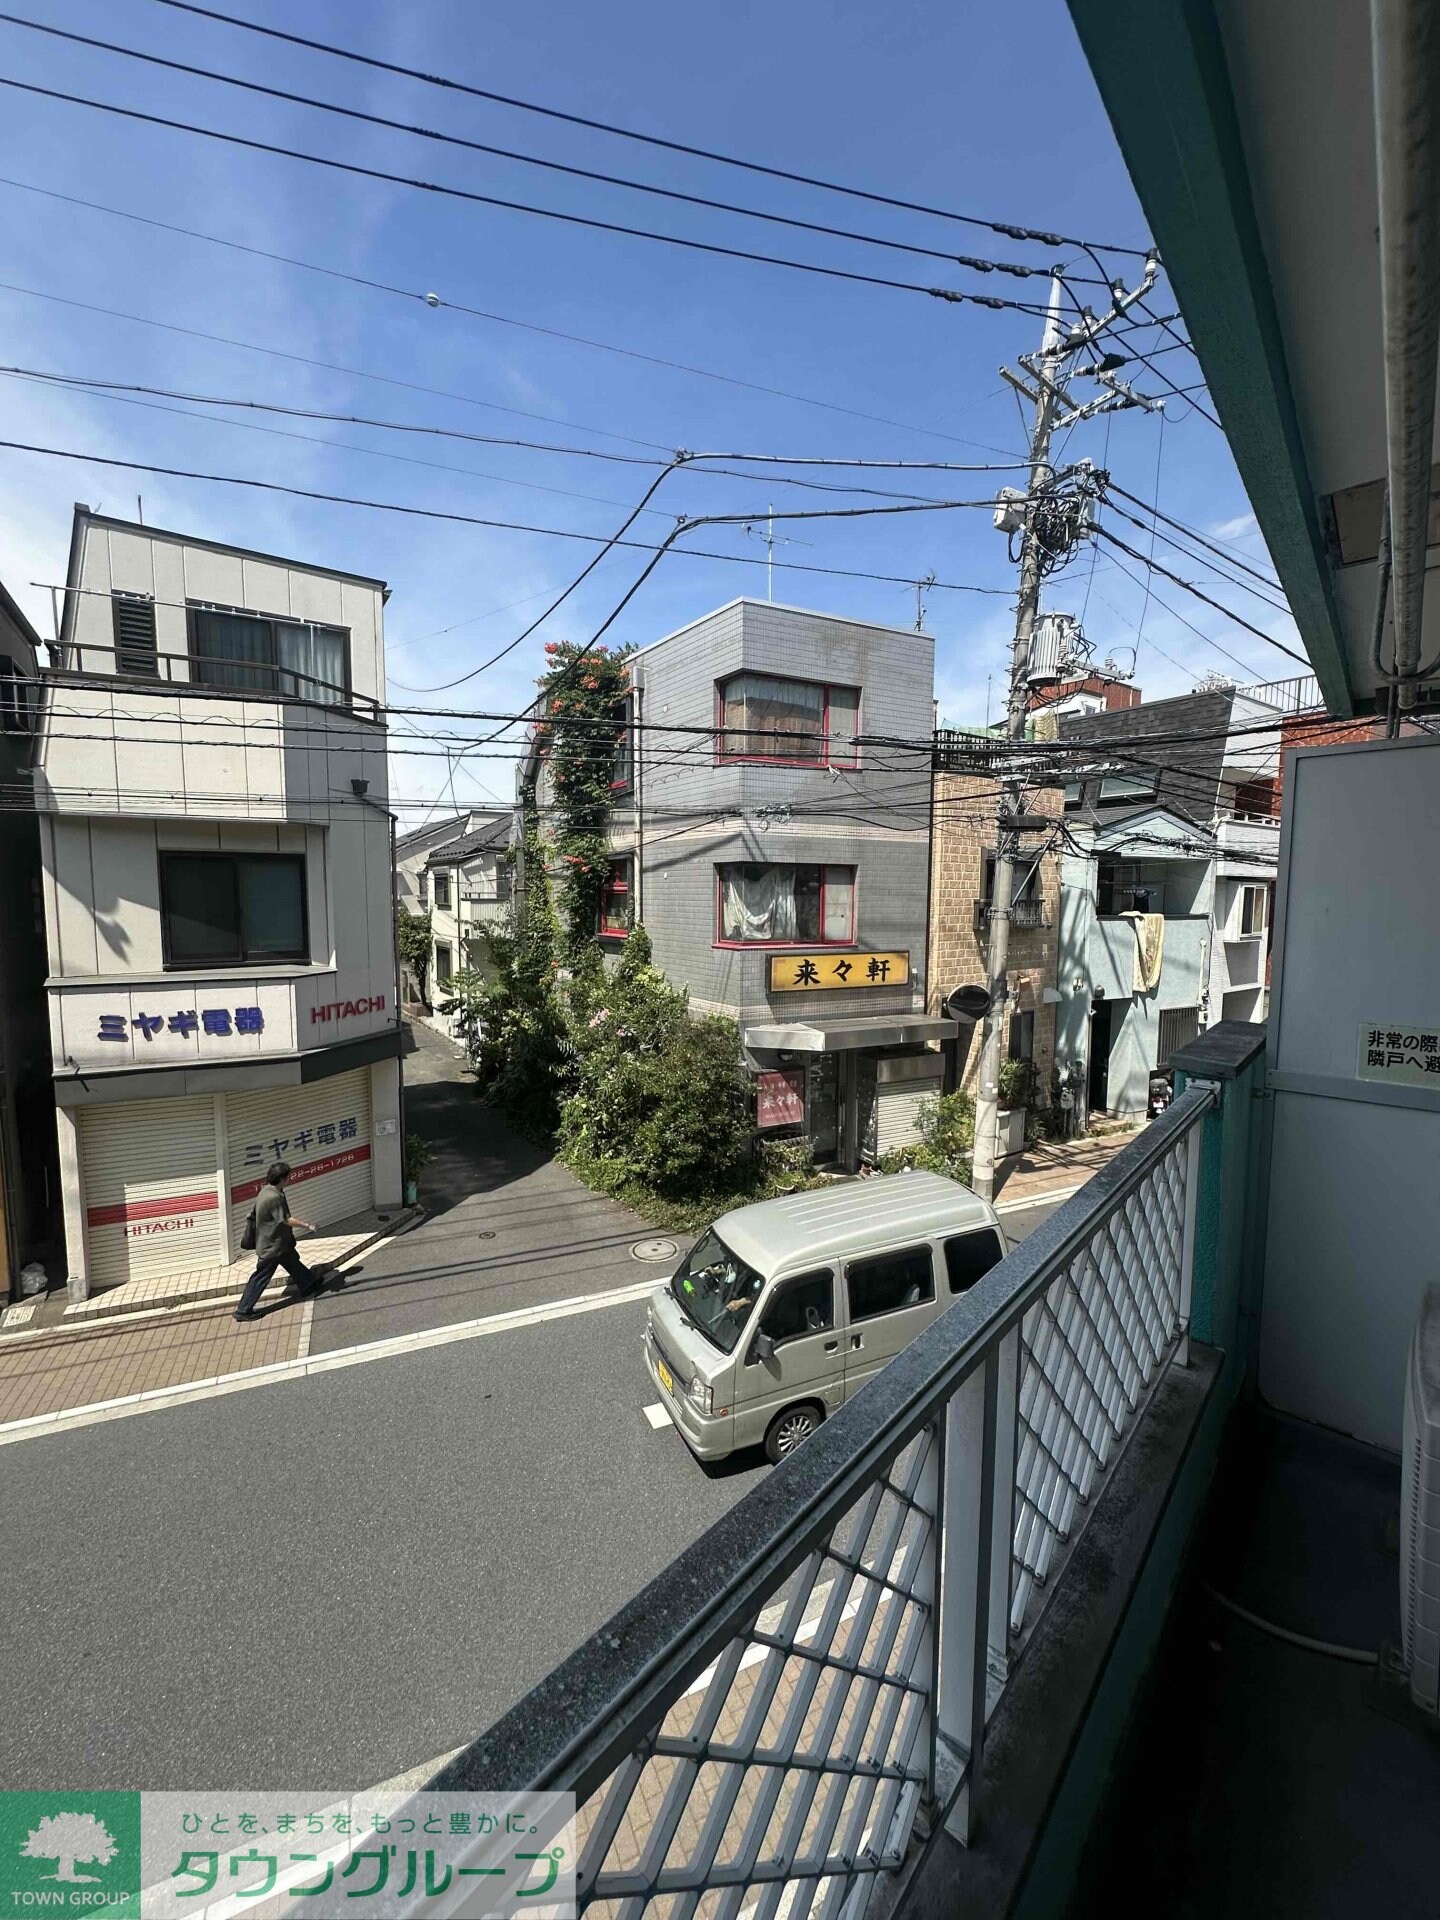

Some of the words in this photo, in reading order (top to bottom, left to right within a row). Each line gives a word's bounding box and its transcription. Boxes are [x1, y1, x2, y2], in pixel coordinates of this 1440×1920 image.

[792, 957, 891, 986] 来々軒
[97, 1006, 264, 1042] ミヤギ電器
[311, 995, 386, 1024] HITACHI
[1367, 1030, 1440, 1053] 非常の際
[243, 1117, 358, 1166] ミヤギ電器
[124, 1218, 194, 1237] HITACHI
